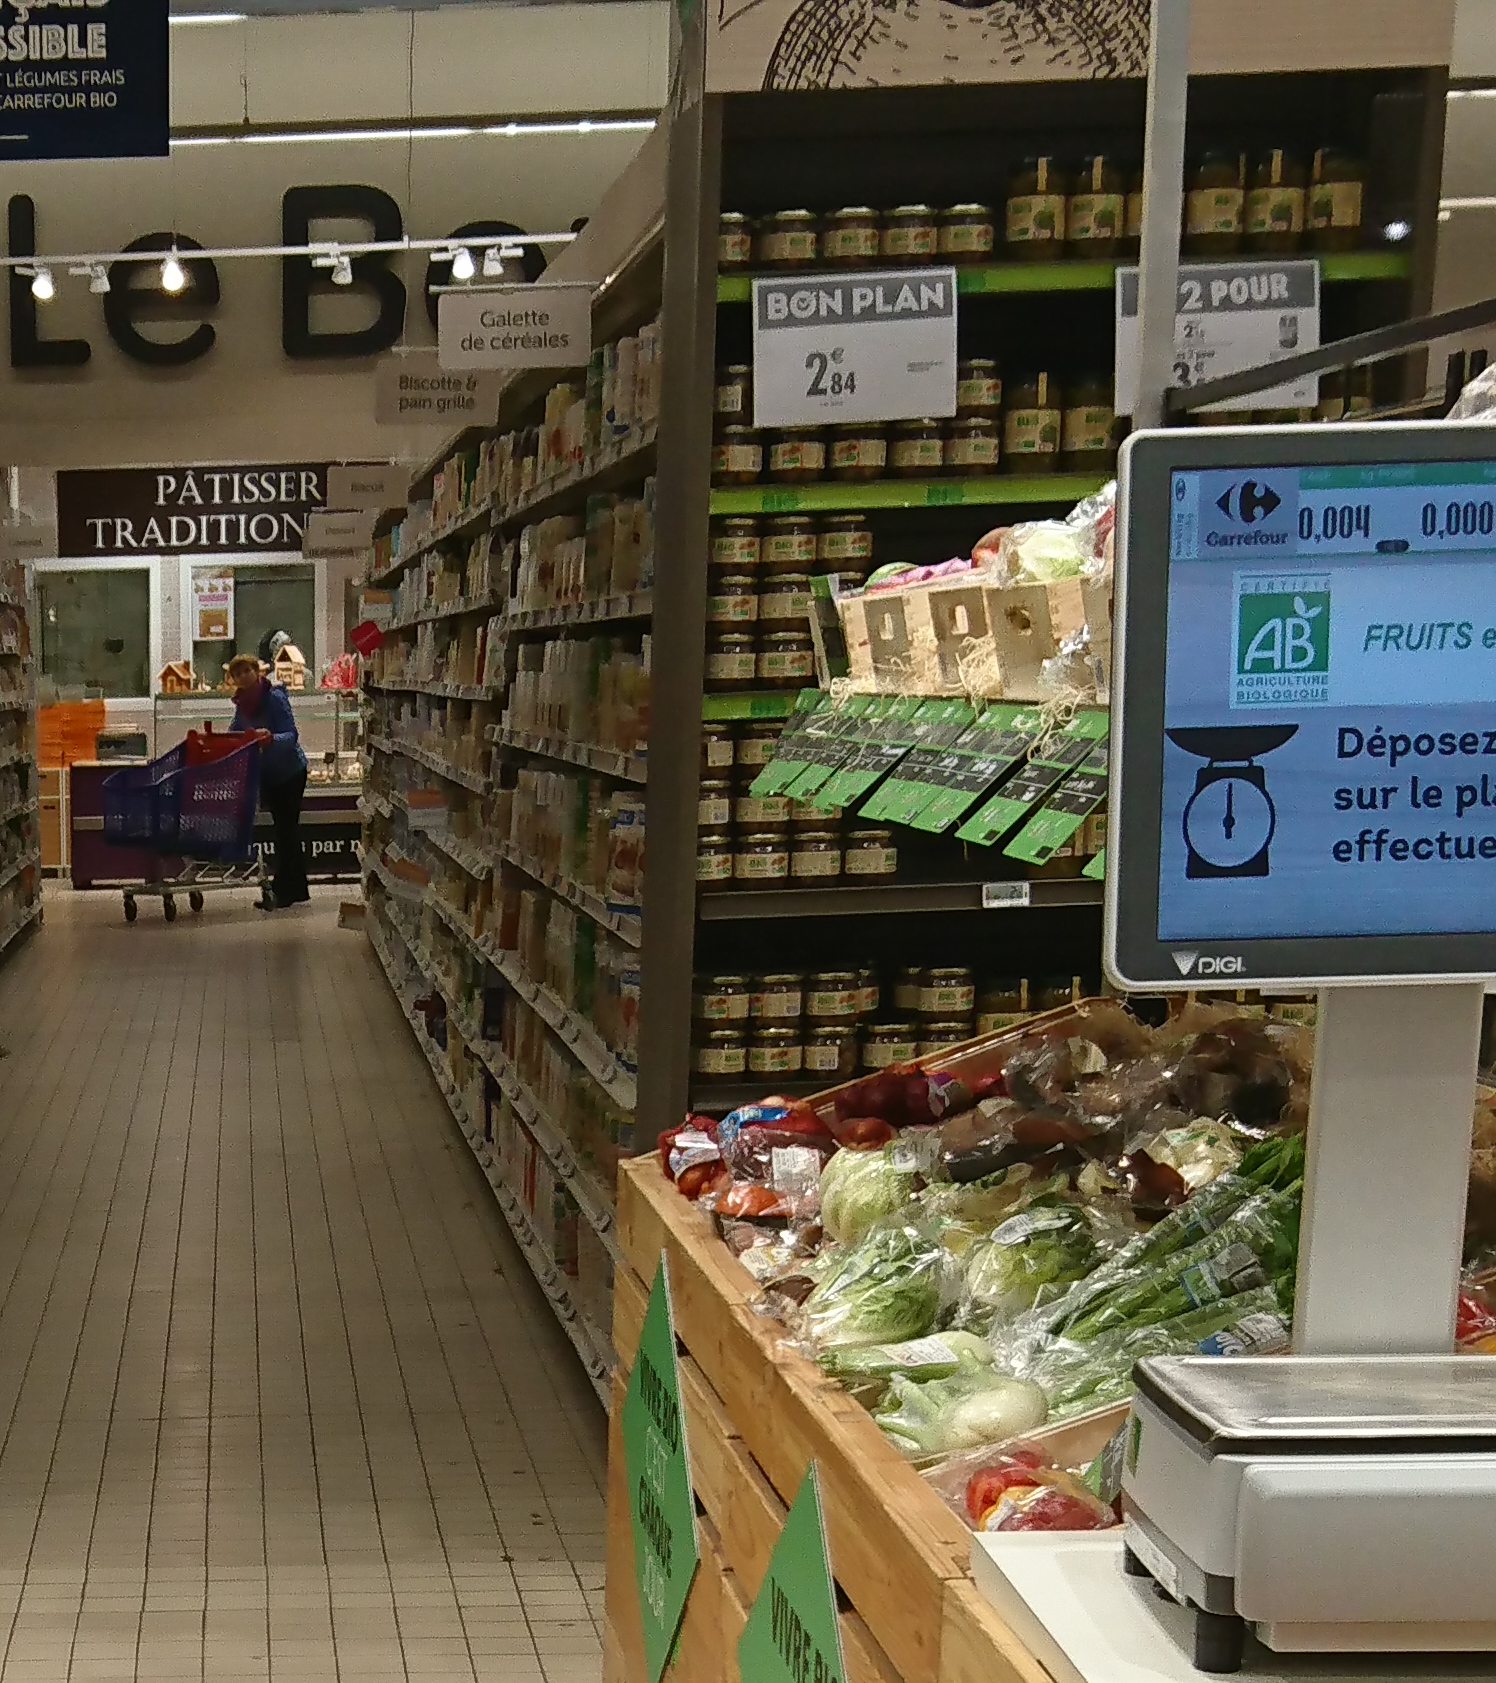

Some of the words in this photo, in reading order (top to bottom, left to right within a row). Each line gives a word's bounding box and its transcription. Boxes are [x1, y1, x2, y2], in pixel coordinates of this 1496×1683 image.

[6, 68, 78, 88] LÉGUMES
[81, 69, 125, 86] FRAIS
[90, 91, 118, 108] BIO
[8, 194, 220, 366] Le
[1180, 280, 1203, 311] 2
[1210, 273, 1289, 306] POUR
[766, 288, 843, 321] BON
[852, 281, 944, 316] PLAN
[480, 309, 550, 329] Galette
[461, 333, 485, 351] de
[490, 331, 570, 350] céréales
[399, 374, 462, 390] Biscotte
[399, 395, 432, 413] pain
[155, 470, 323, 506] PÂTISSER
[1298, 503, 1371, 543] 0,004
[1421, 500, 1494, 540] 0,000
[1206, 530, 1289, 548] Carrefour
[1244, 617, 1316, 671] AB
[1362, 622, 1473, 652] FRUITS
[1333, 782, 1398, 811] sur
[1410, 777, 1442, 810] le
[1198, 955, 1244, 975] DIGI
[639, 1475, 673, 1579] CHAQUE
